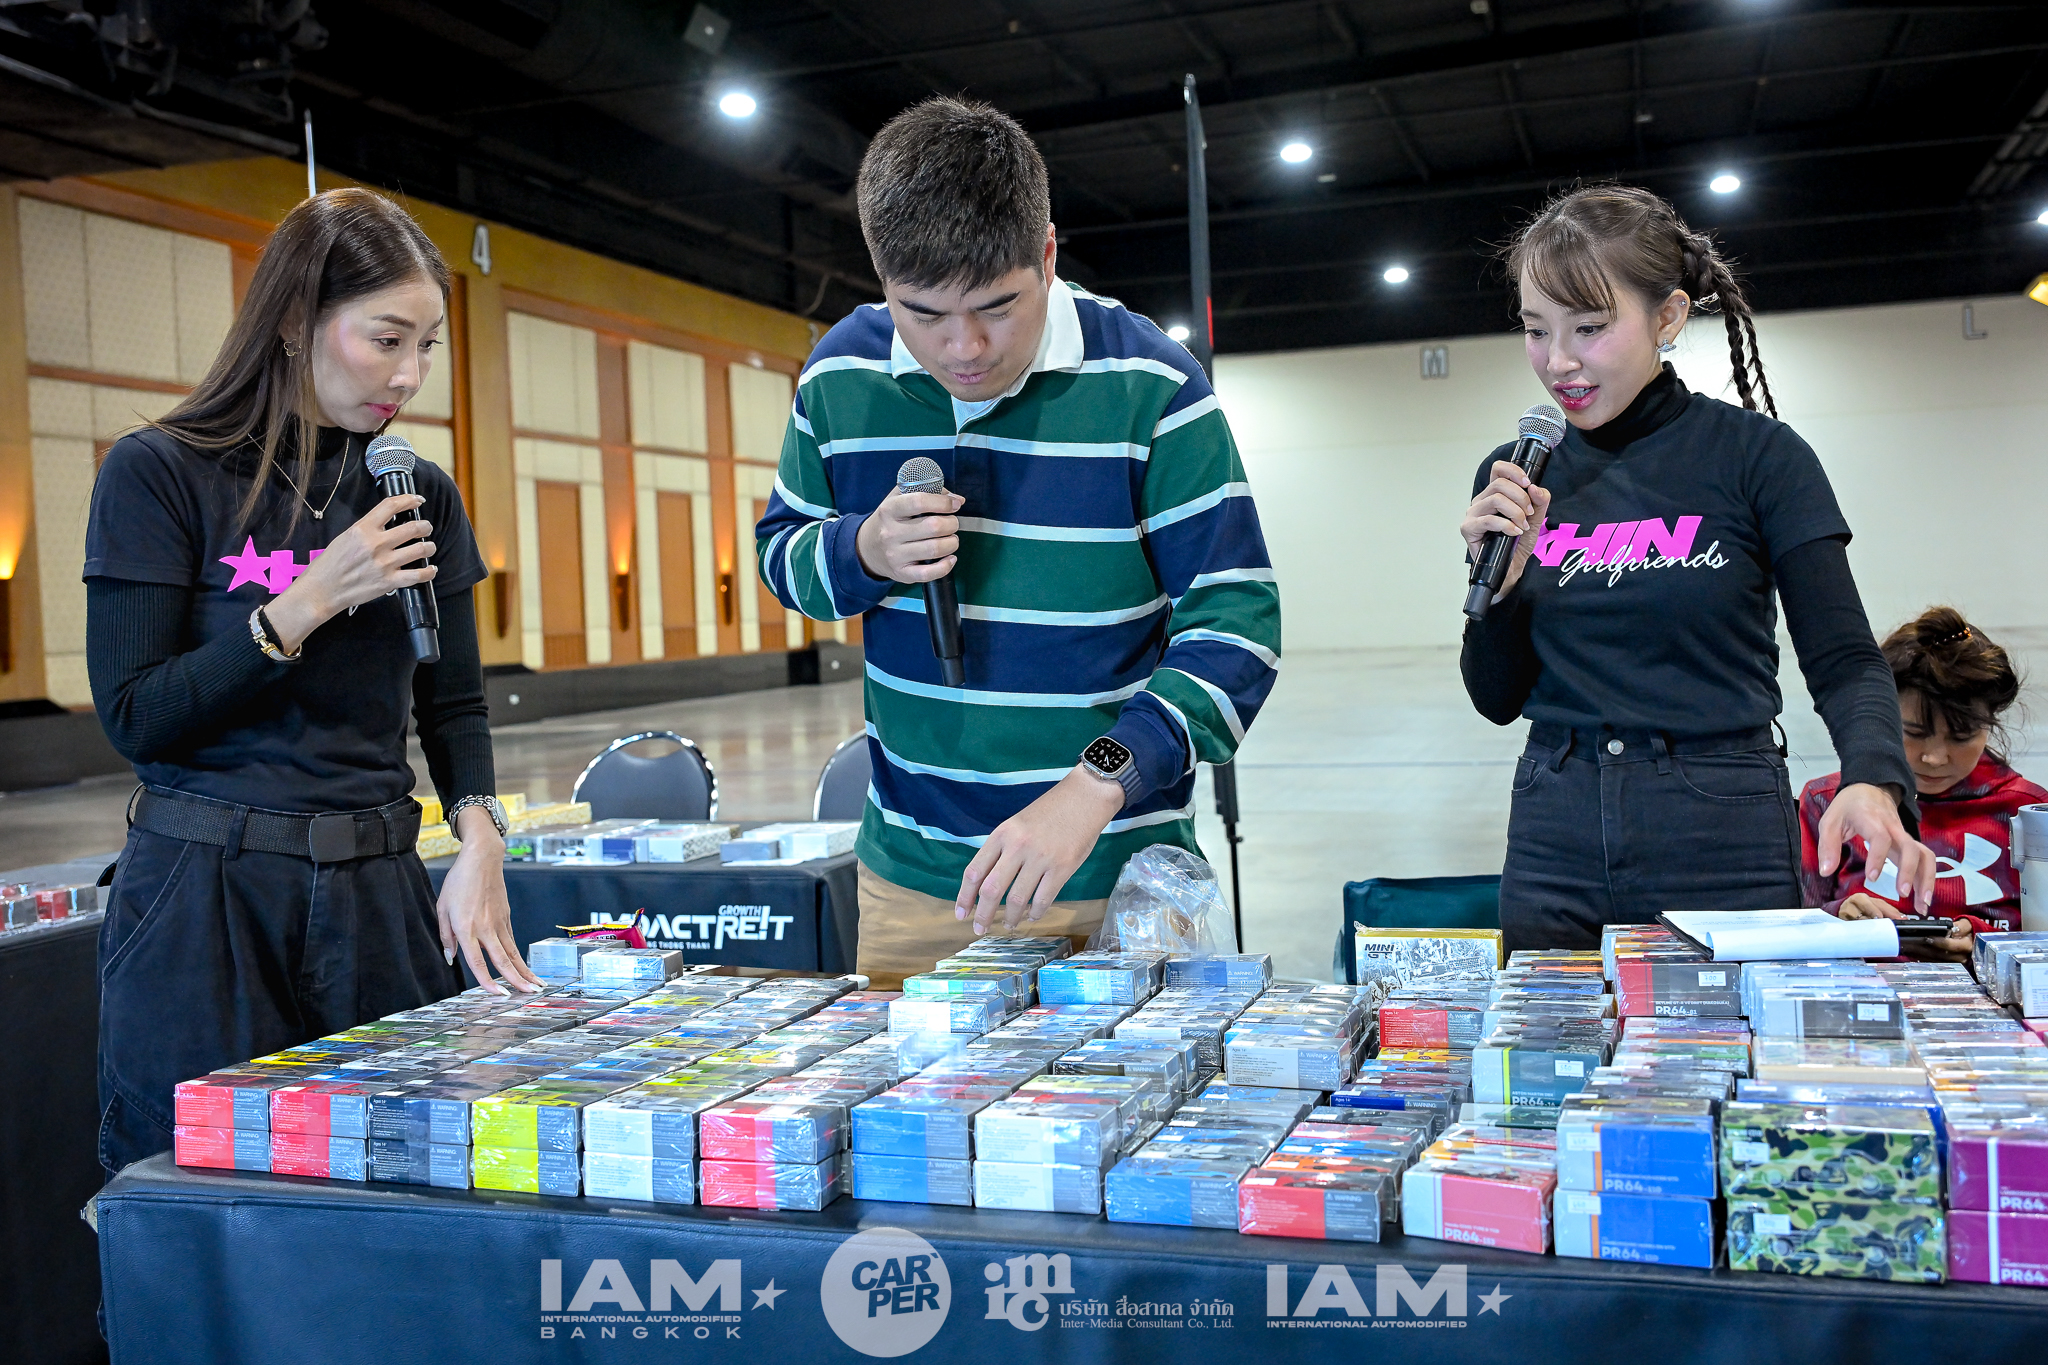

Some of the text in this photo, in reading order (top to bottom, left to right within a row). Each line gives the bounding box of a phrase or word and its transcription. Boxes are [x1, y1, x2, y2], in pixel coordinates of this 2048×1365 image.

[472, 224, 492, 275] 4
[1559, 540, 1729, 587] Girlfriends
[719, 905, 761, 916] GROWTH
[659, 941, 684, 951] THONG
[686, 942, 710, 951] THANI
